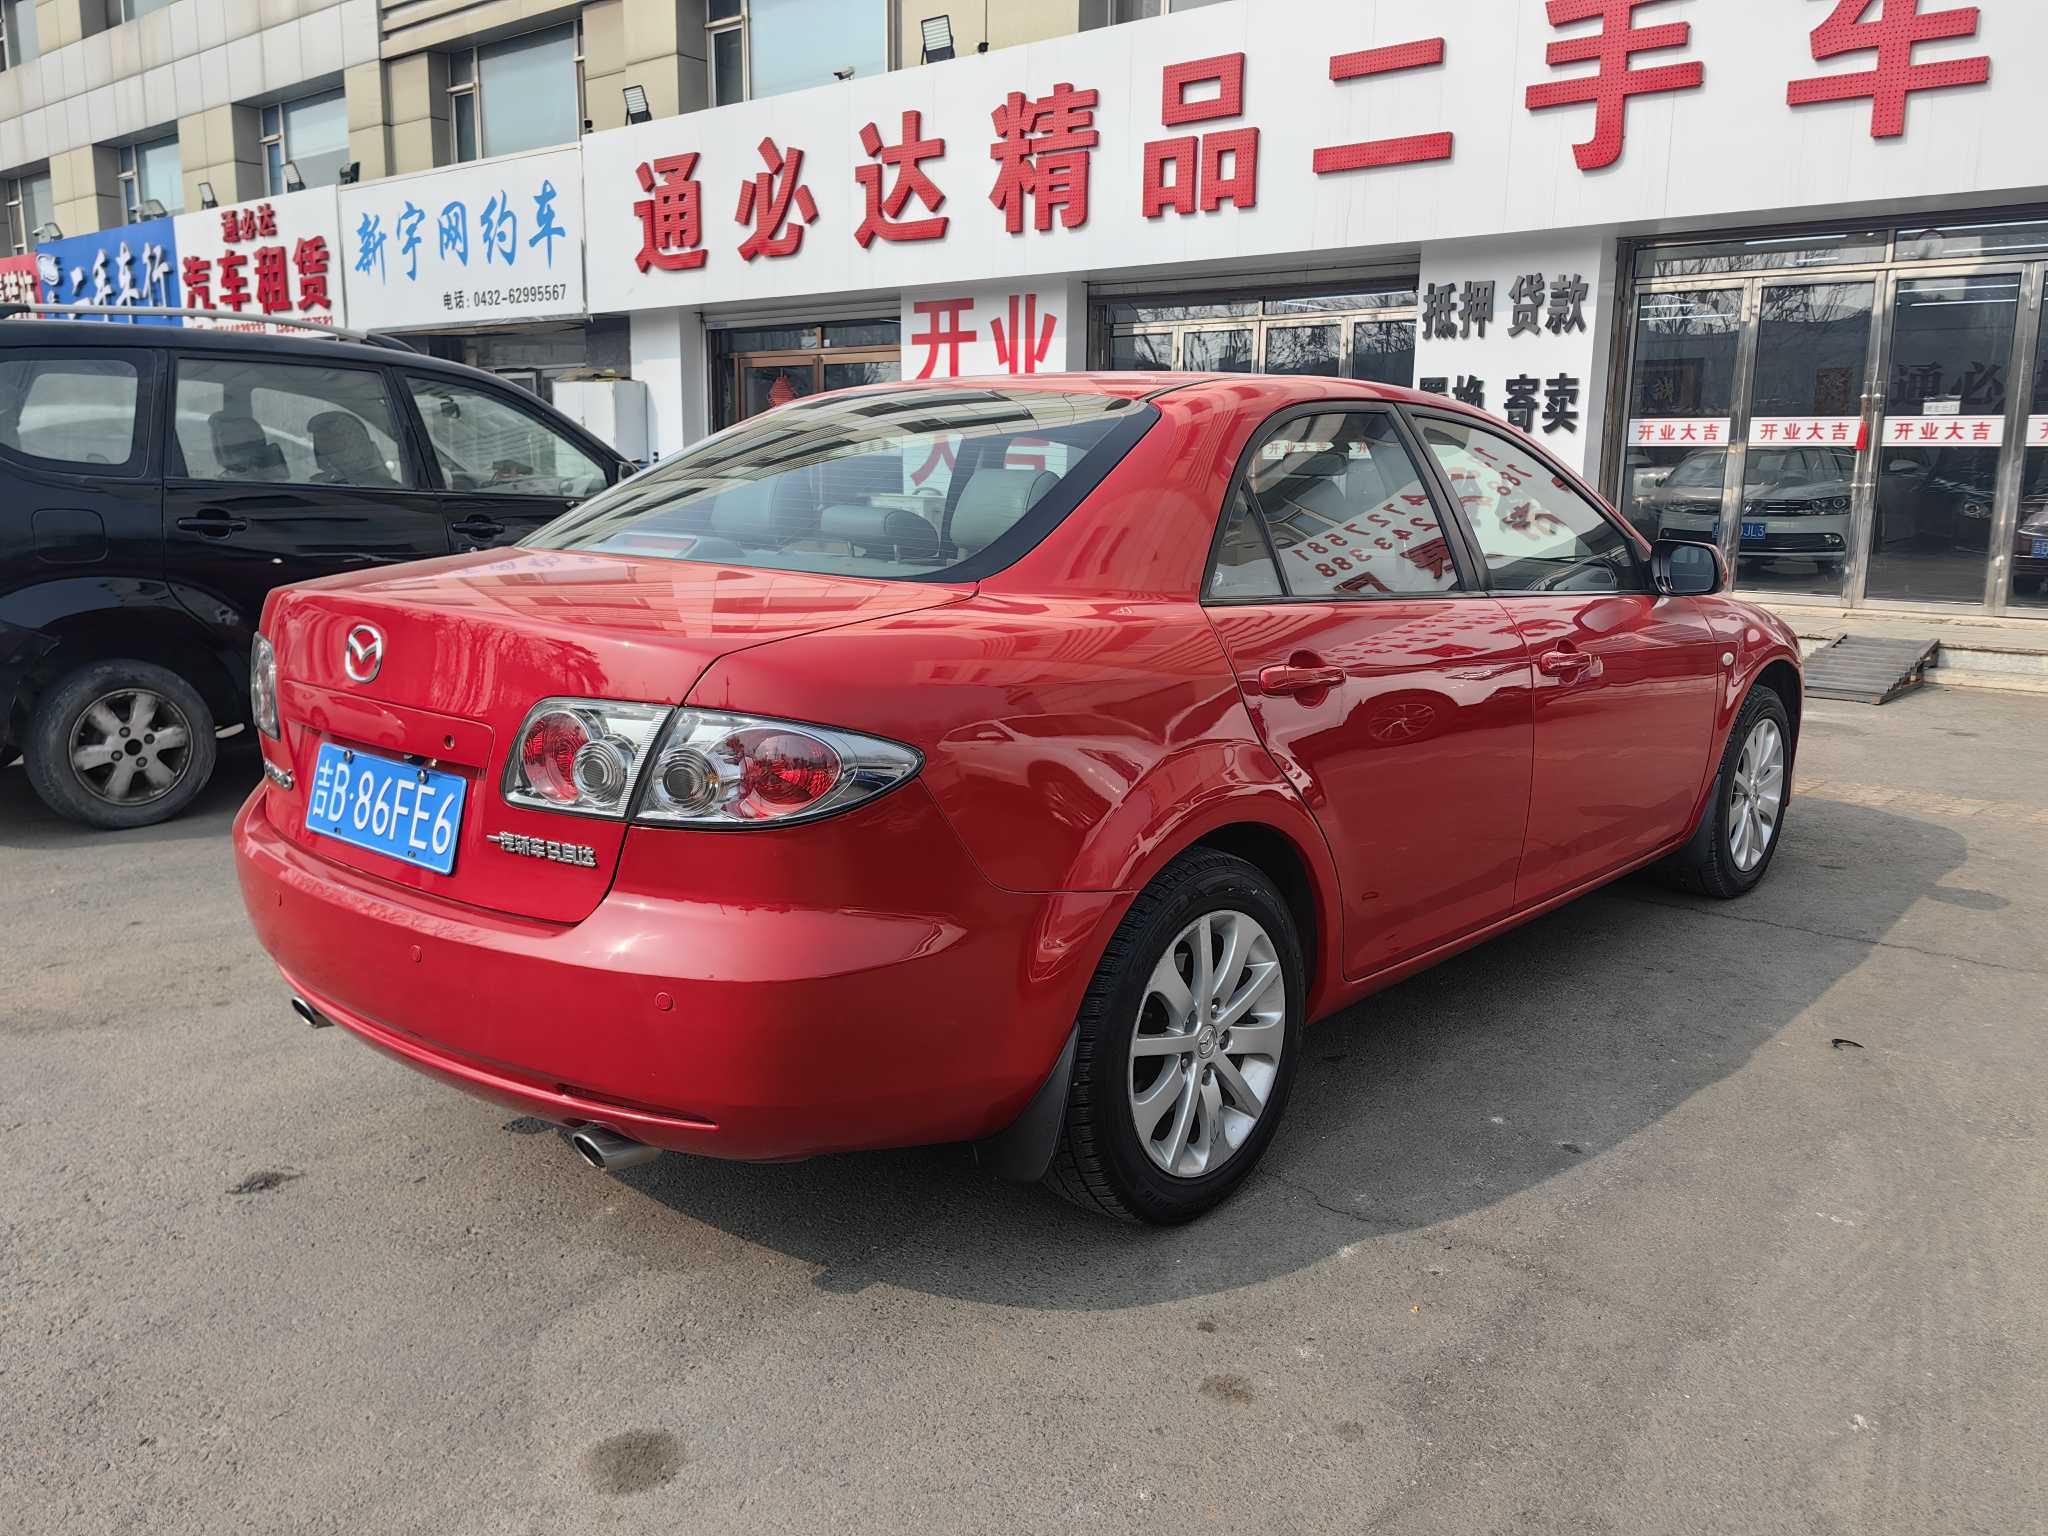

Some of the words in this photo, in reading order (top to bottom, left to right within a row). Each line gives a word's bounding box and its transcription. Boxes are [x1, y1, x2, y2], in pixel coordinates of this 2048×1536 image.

[634, 0, 1991, 273] 通必达精品二手车
[221, 203, 277, 243] 通必达
[355, 179, 567, 285] 新宇网约车
[182, 236, 332, 315] 汽车租赁
[474, 283, 567, 308] 0432-62995567
[1422, 280, 1496, 340] 抵押
[1507, 272, 1589, 337] 贷款
[911, 293, 1058, 380] 开业
[1504, 372, 1580, 434] 寄卖
[1637, 422, 1721, 441] 开业大吉
[1760, 422, 1850, 441] 开业大吉
[1895, 421, 1992, 441] 开业大吉
